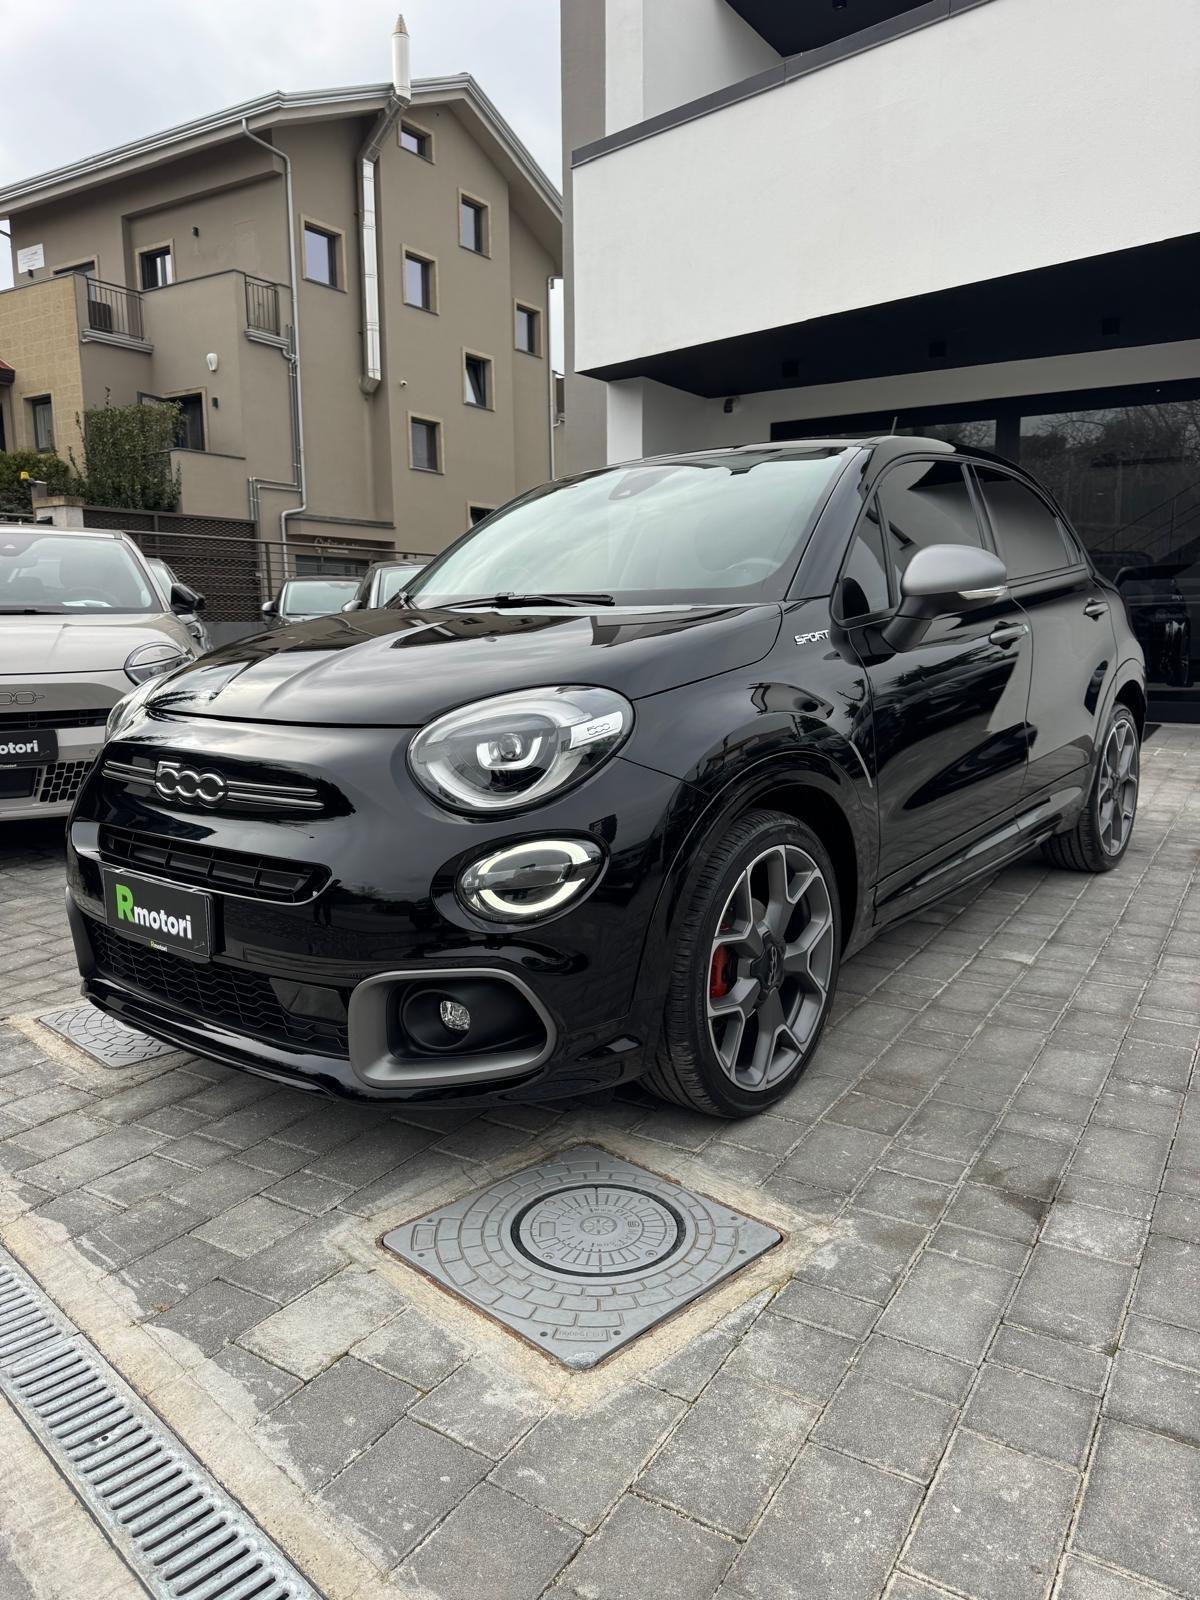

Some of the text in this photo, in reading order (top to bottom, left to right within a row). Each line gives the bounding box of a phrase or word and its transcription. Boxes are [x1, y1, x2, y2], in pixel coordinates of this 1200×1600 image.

[794, 630, 829, 645] SPORT
[586, 723, 611, 736] 500
[156, 760, 225, 802] 500
[115, 883, 192, 940] Rmotori
